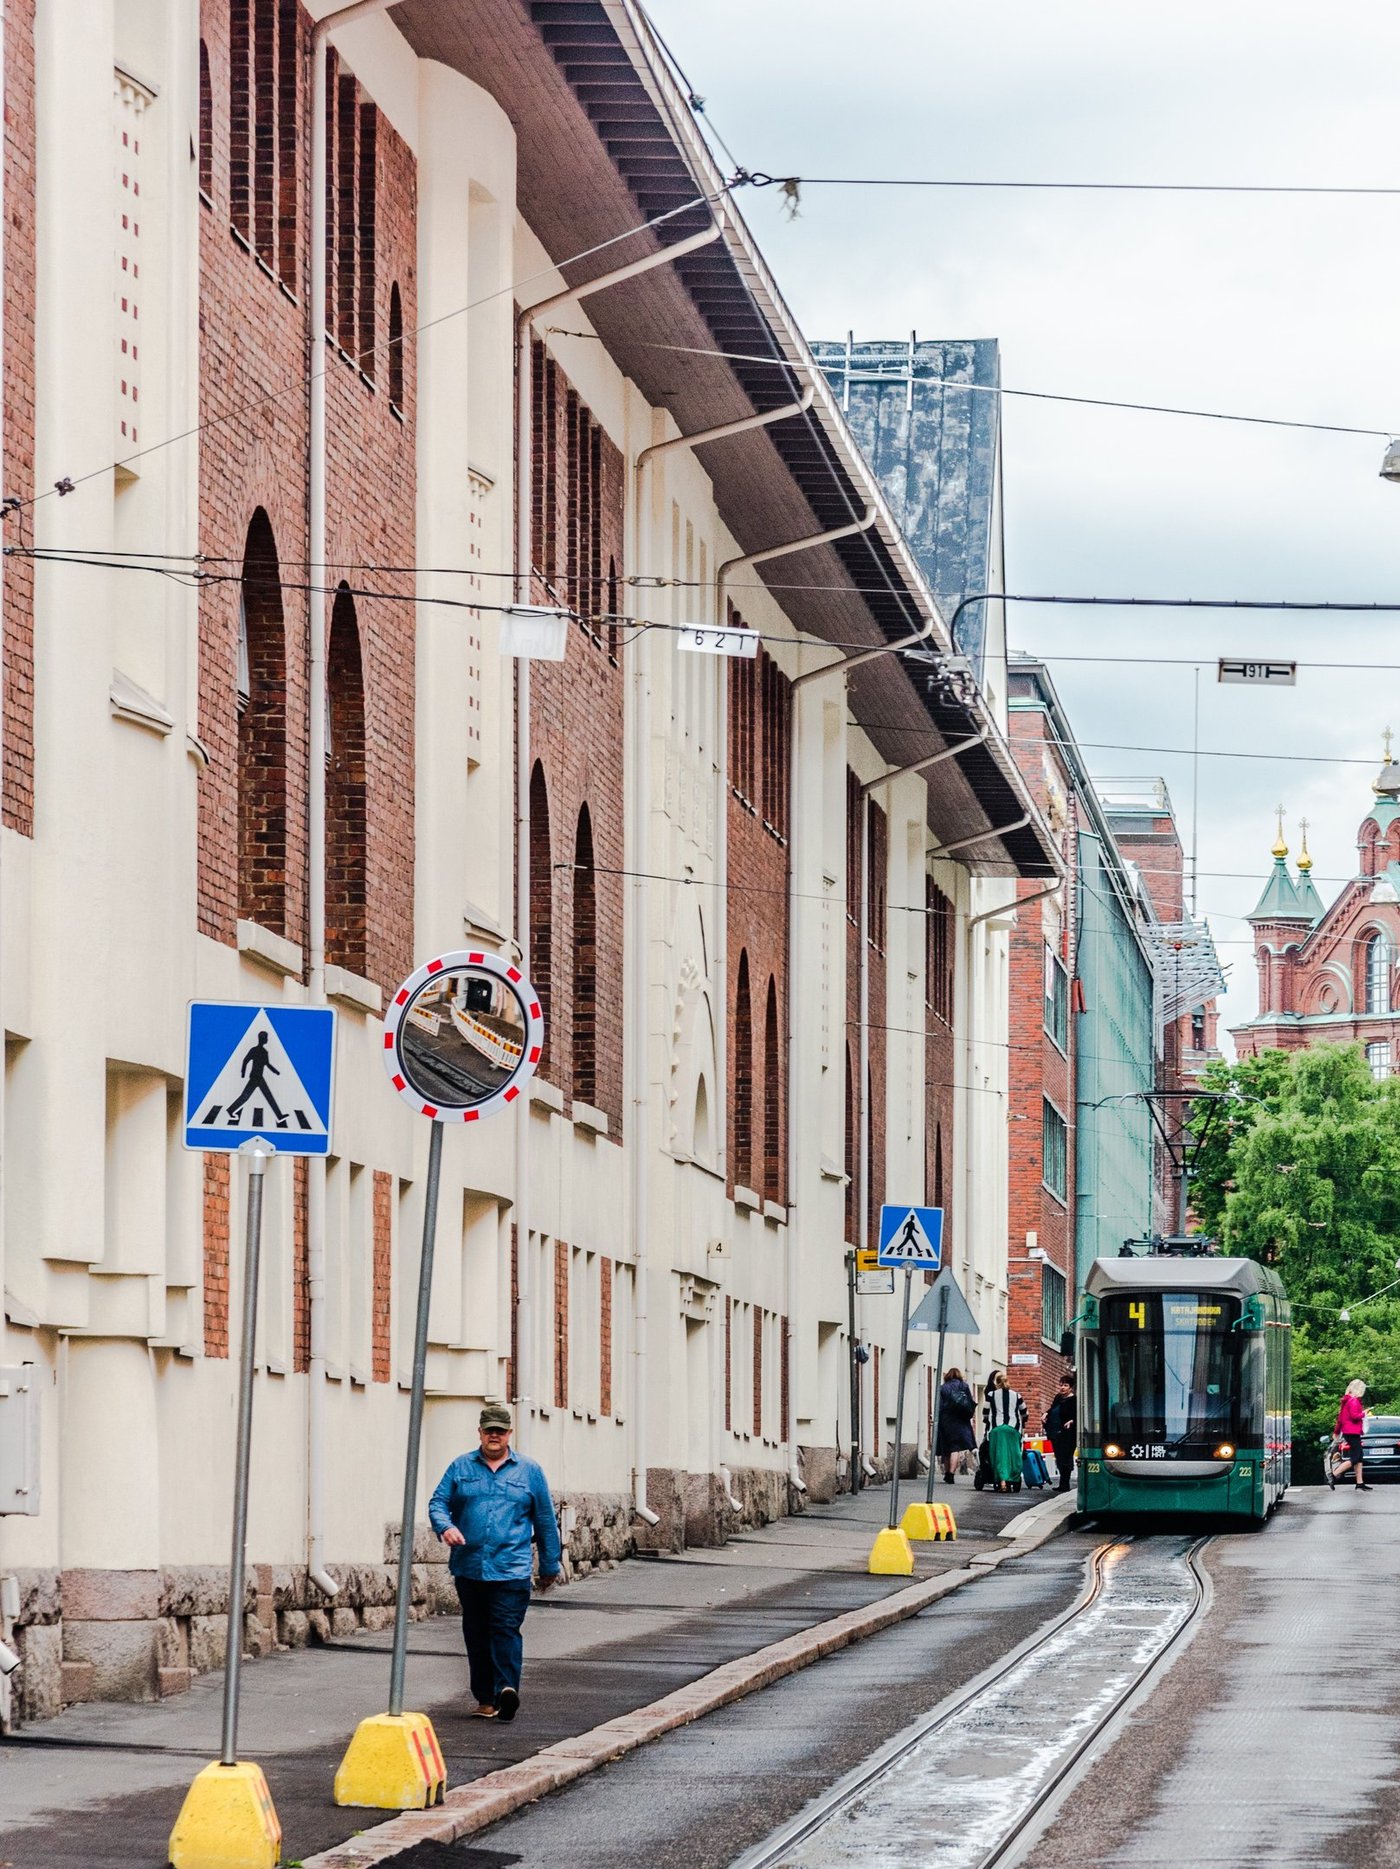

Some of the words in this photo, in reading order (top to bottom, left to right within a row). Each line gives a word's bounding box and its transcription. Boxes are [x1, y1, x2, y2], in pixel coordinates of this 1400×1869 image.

[716, 1242, 722, 1253] 4
[1129, 1302, 1145, 1329] 4
[1087, 1463, 1100, 1473] 223
[1239, 1466, 1252, 1477] 223
